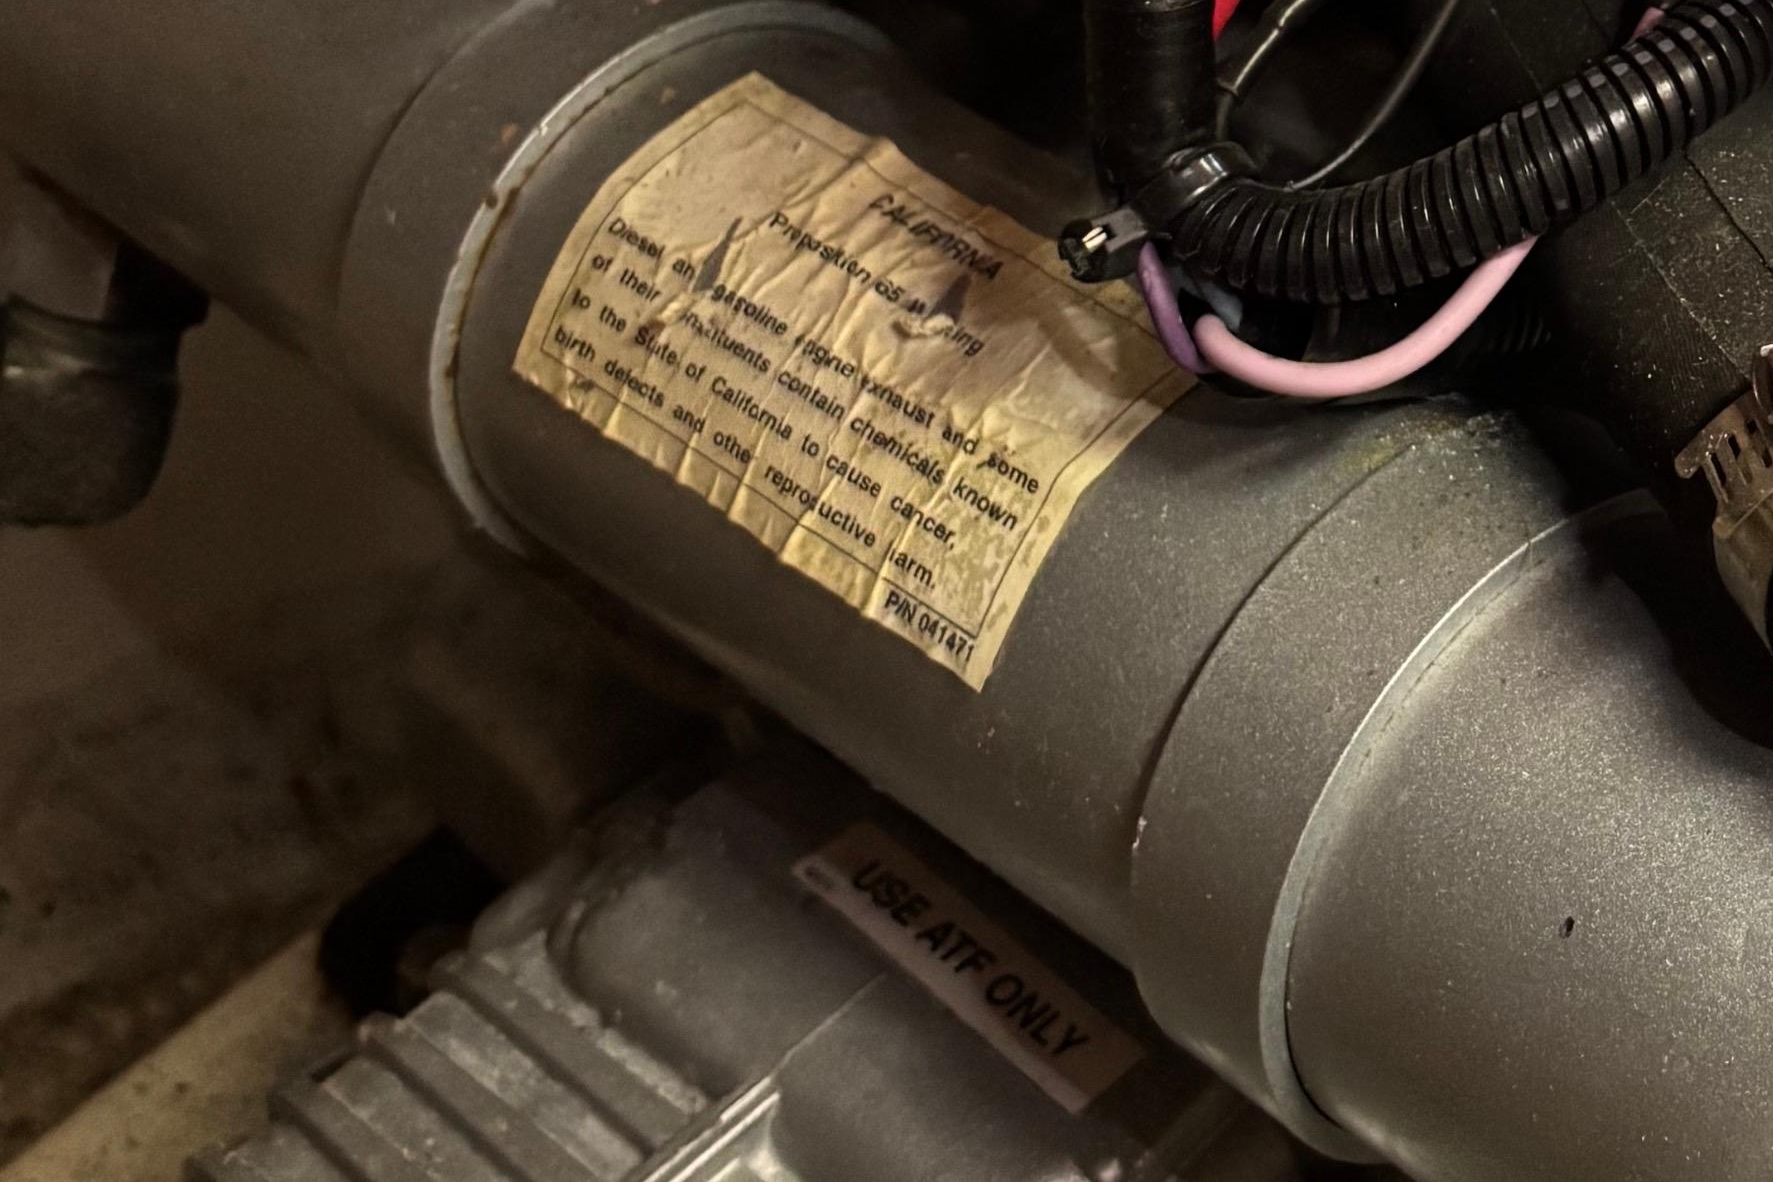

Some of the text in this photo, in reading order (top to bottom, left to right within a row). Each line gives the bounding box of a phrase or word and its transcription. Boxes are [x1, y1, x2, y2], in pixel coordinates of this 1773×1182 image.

[555, 324, 597, 362] birth
[604, 358, 665, 408] defects
[673, 403, 705, 433] and
[713, 430, 752, 465] othe
[572, 287, 591, 310] to
[599, 305, 627, 333] the
[685, 362, 707, 384] of
[711, 375, 792, 441] California
[802, 433, 820, 457] to
[826, 457, 881, 498] cause
[890, 494, 955, 551] cancer,
[592, 254, 613, 274] of
[619, 267, 662, 303] their
[778, 371, 845, 420] contain
[850, 416, 944, 485] chemicals
[952, 476, 1018, 531] known
[607, 217, 665, 260] Diesel
[672, 258, 697, 282] an
[942, 426, 980, 456] and
[986, 452, 1040, 495] some
[884, 589, 975, 663] P/N 041471
[853, 862, 1090, 1055] USE ATF ONLY
